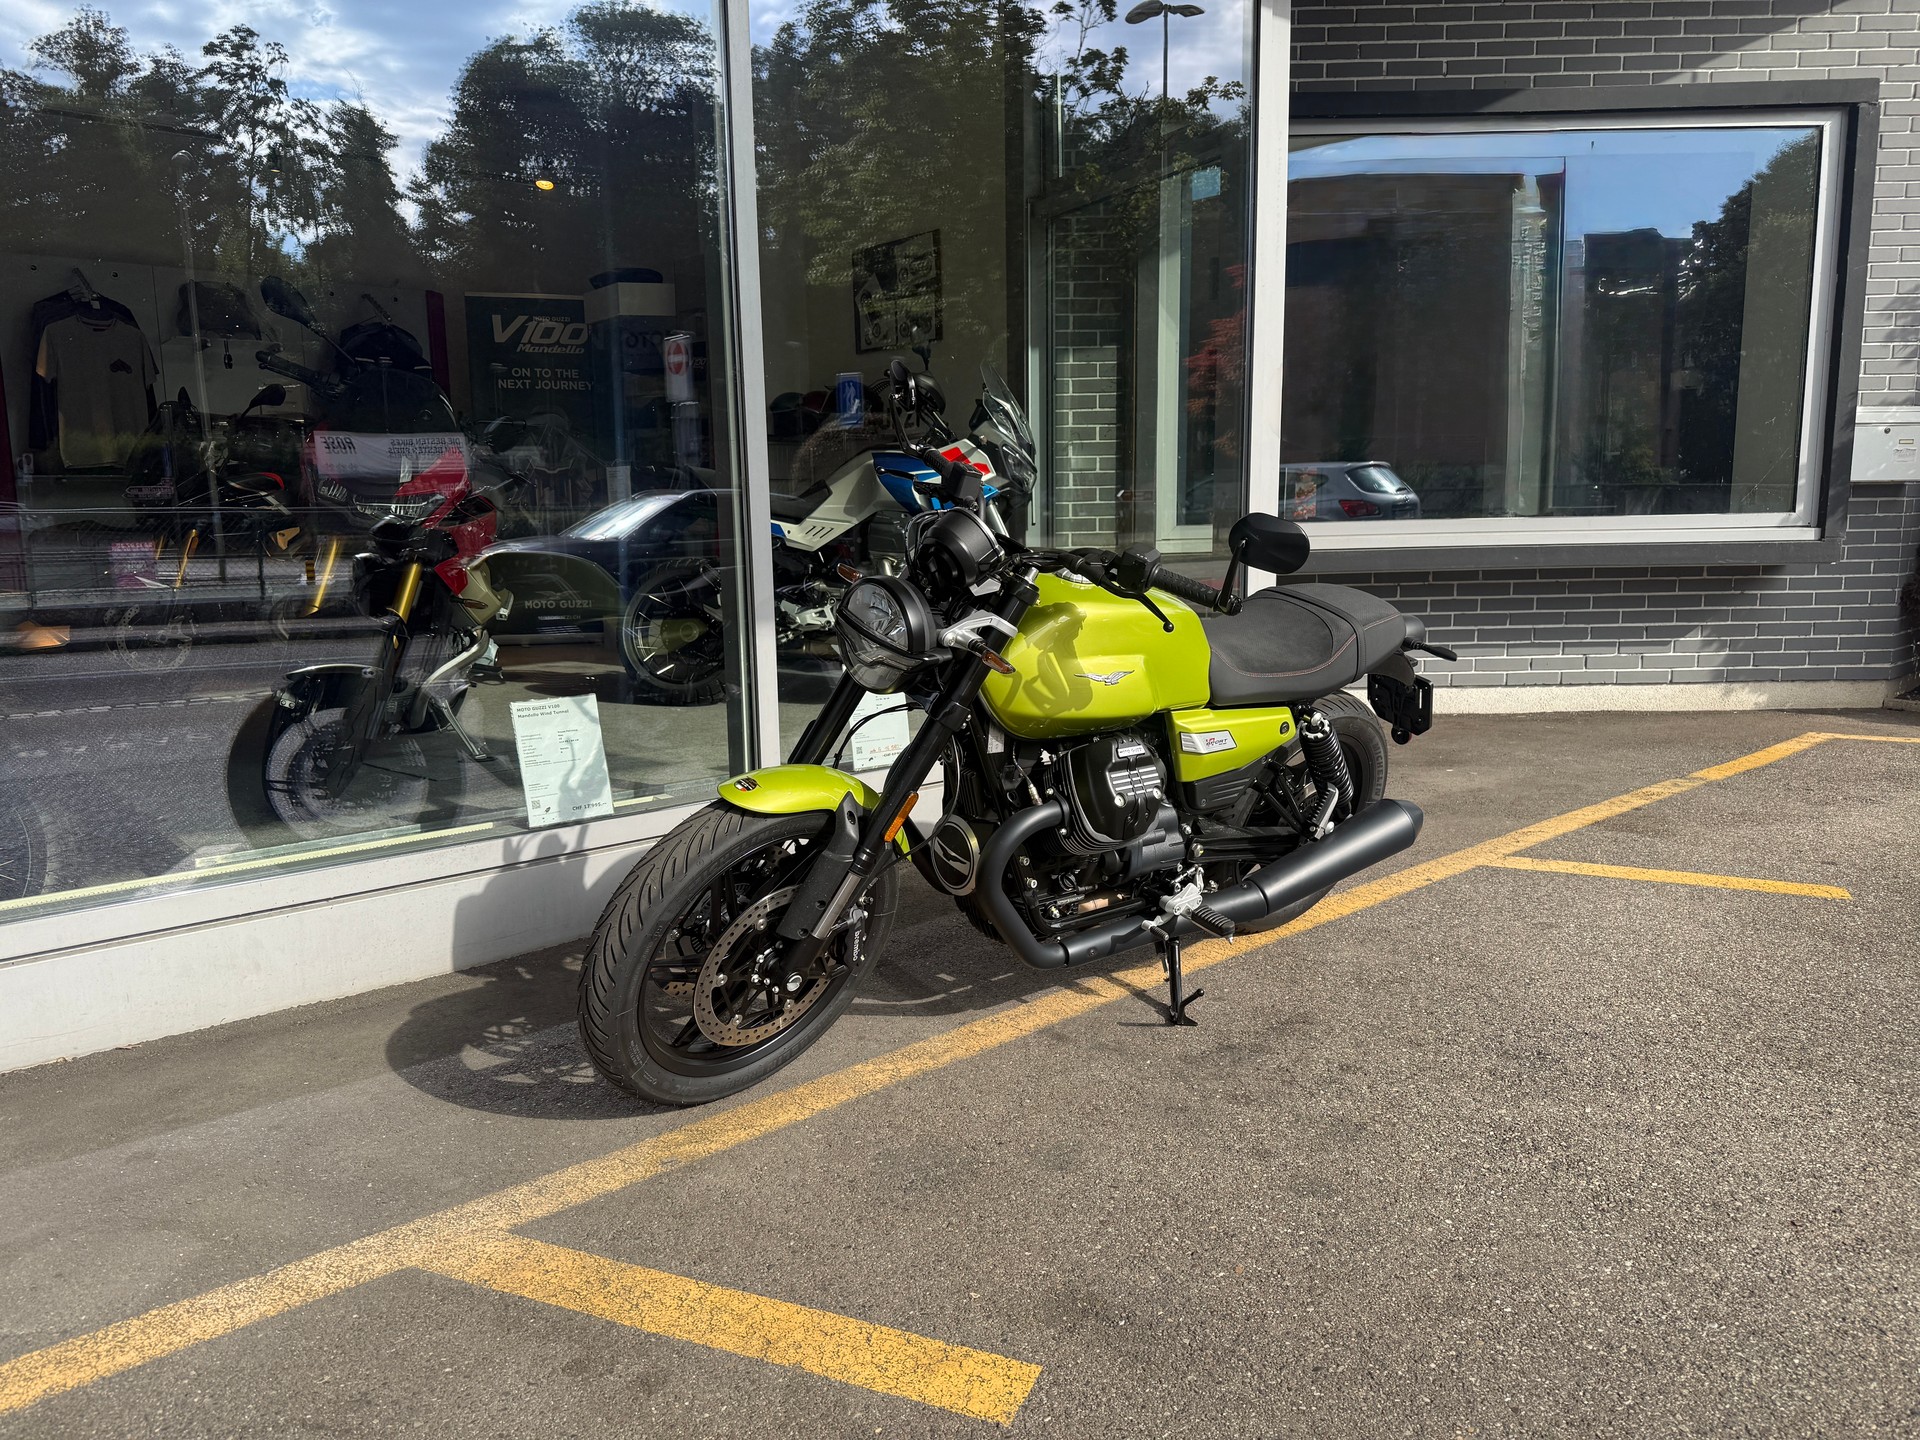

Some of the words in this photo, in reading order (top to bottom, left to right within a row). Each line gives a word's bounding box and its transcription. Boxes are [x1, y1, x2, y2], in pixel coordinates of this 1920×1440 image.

[492, 314, 588, 344] V100
[516, 343, 585, 354] Mandello
[511, 367, 530, 379] ON
[534, 368, 551, 379] TO
[554, 368, 579, 379] THE
[498, 379, 531, 389] NEXT
[535, 379, 594, 391] JOURNEY
[524, 600, 556, 609] MOTO
[559, 599, 592, 609] GUZZI
[1371, 742, 1385, 797] MICHELIN
